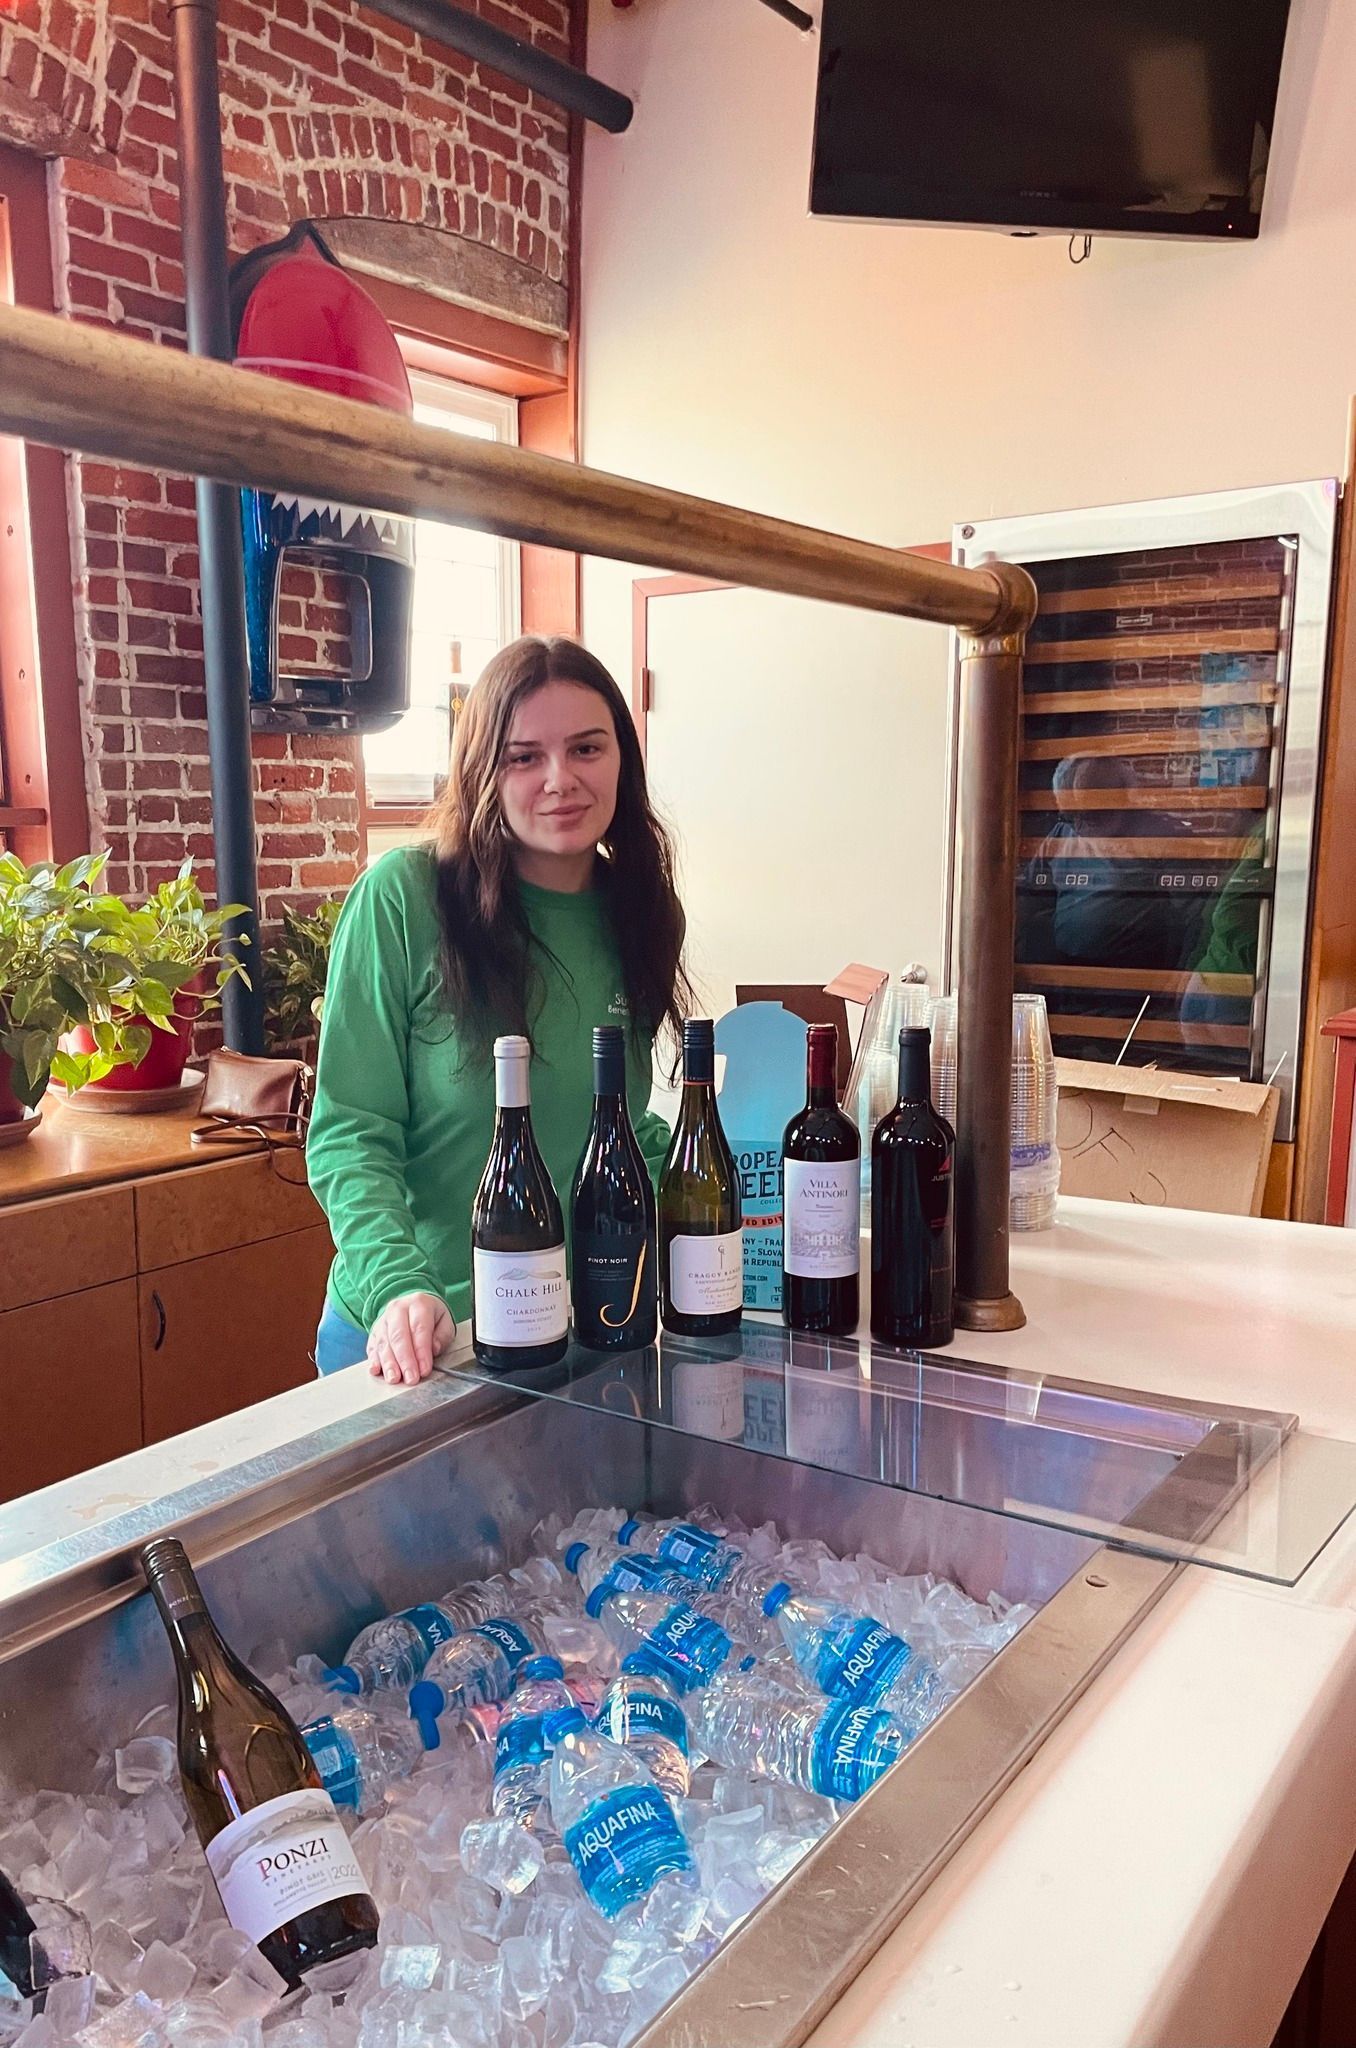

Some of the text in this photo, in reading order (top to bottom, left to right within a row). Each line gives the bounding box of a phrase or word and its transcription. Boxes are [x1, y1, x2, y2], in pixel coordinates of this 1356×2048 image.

[809, 1179, 838, 1189] VILLA
[800, 1188, 848, 1198] ANTINORI
[587, 1257, 628, 1265] PINOT NOIR
[495, 1282, 562, 1298] CHALK HILL
[506, 1304, 557, 1316] CHARDONNAY
[577, 1800, 662, 1867] AQUAFINA
[256, 1837, 329, 1882] PONZI
